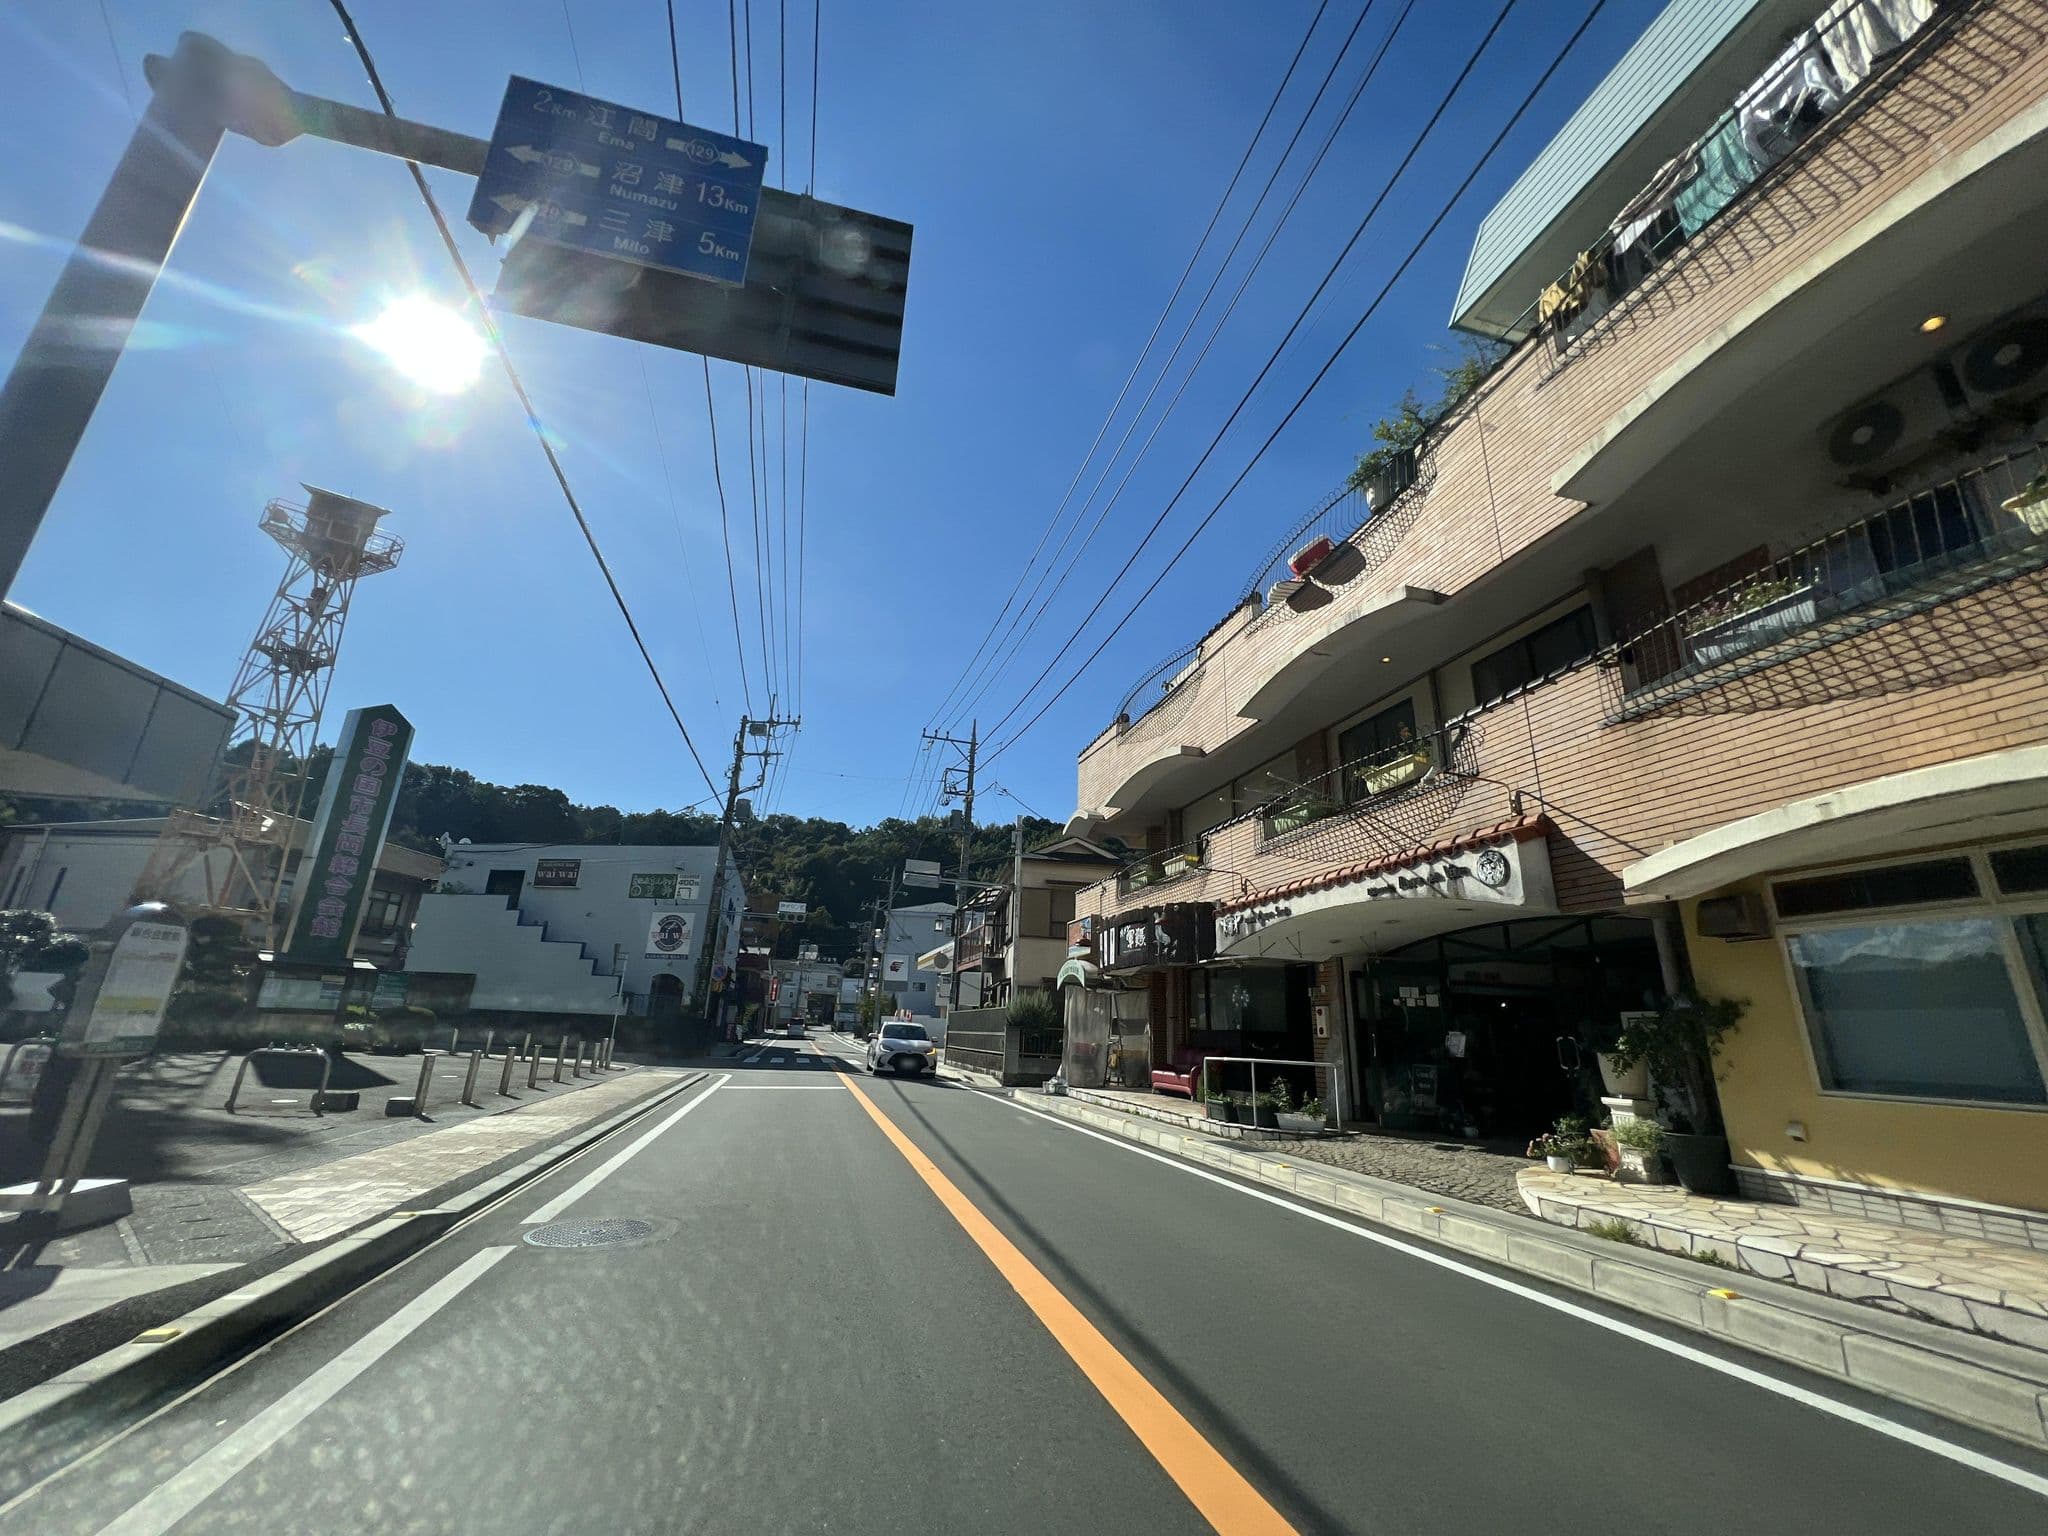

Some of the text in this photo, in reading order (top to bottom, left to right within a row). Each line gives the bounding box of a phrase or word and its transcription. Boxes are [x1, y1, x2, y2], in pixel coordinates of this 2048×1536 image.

[585, 104, 659, 141] 江間
[598, 134, 635, 151] Ema
[689, 143, 716, 162] 129
[612, 161, 685, 195] 沼津
[609, 183, 679, 212] Numazu
[602, 211, 676, 243] 三津
[613, 235, 651, 256] Mito
